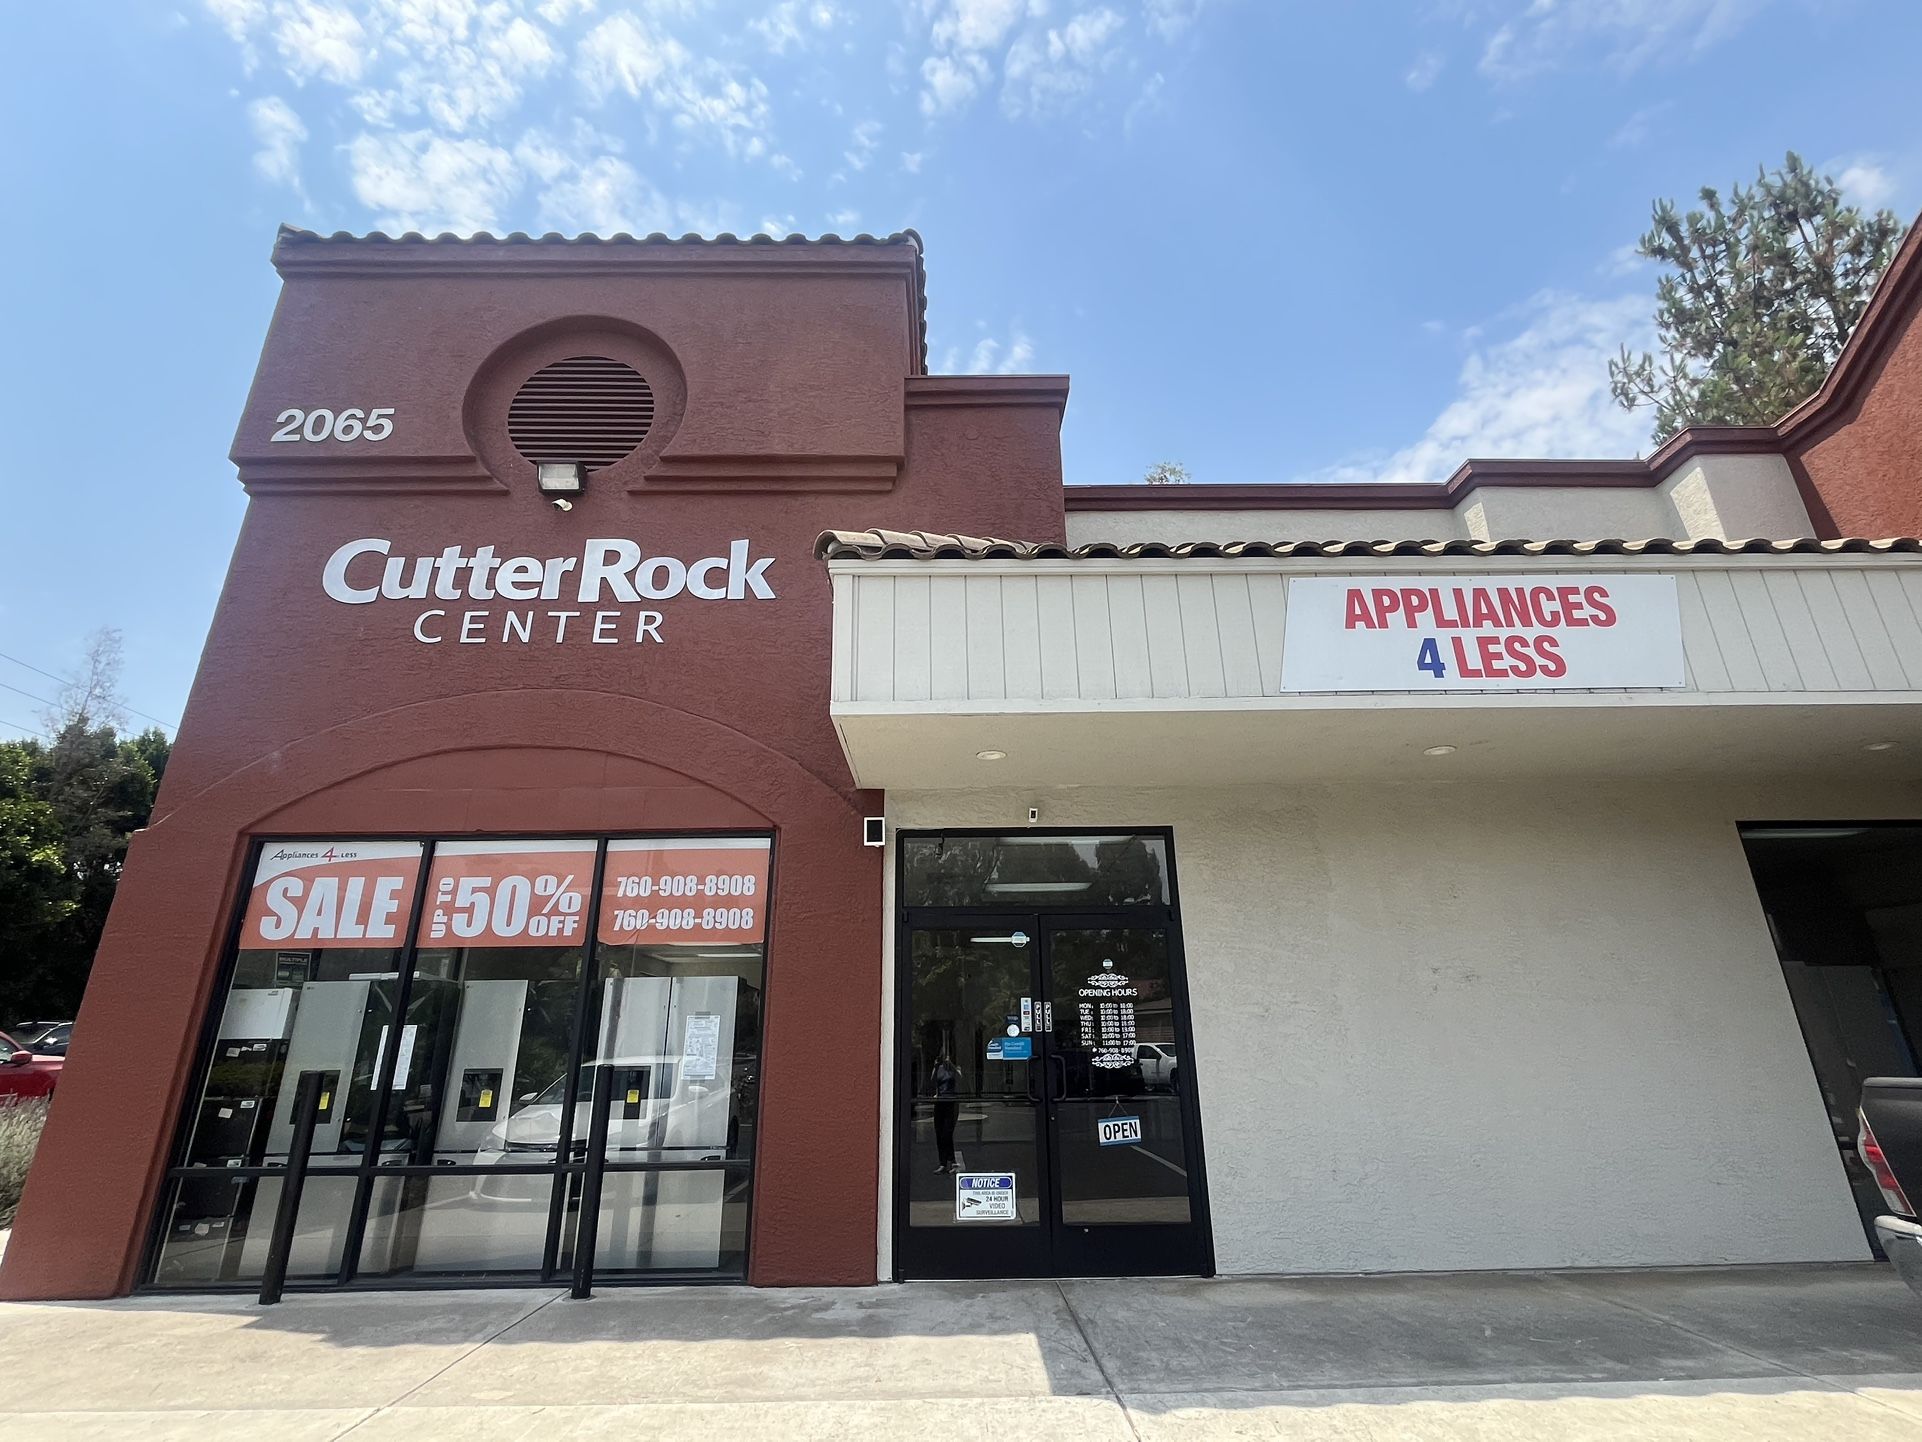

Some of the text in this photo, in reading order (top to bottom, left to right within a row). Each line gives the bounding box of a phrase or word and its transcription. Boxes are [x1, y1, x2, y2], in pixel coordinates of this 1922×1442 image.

[270, 408, 395, 442] 2065
[322, 538, 778, 604] CutterRock
[1344, 585, 1617, 630] APPLIANCES
[412, 610, 665, 643] CENTER
[1416, 634, 1568, 680] 4 LESS
[270, 849, 319, 861] Appliances
[320, 846, 339, 862] 4
[616, 874, 756, 898] 760-908-8908
[259, 876, 404, 941] SALE
[430, 877, 455, 938] UP TO
[451, 875, 582, 938] 50%
[613, 907, 754, 931] 760-908-8908
[528, 915, 580, 937] OFF
[1078, 988, 1138, 997] OPENING HOURS
[1103, 1121, 1138, 1141] OPEN
[971, 1177, 1001, 1188] NOTICE
